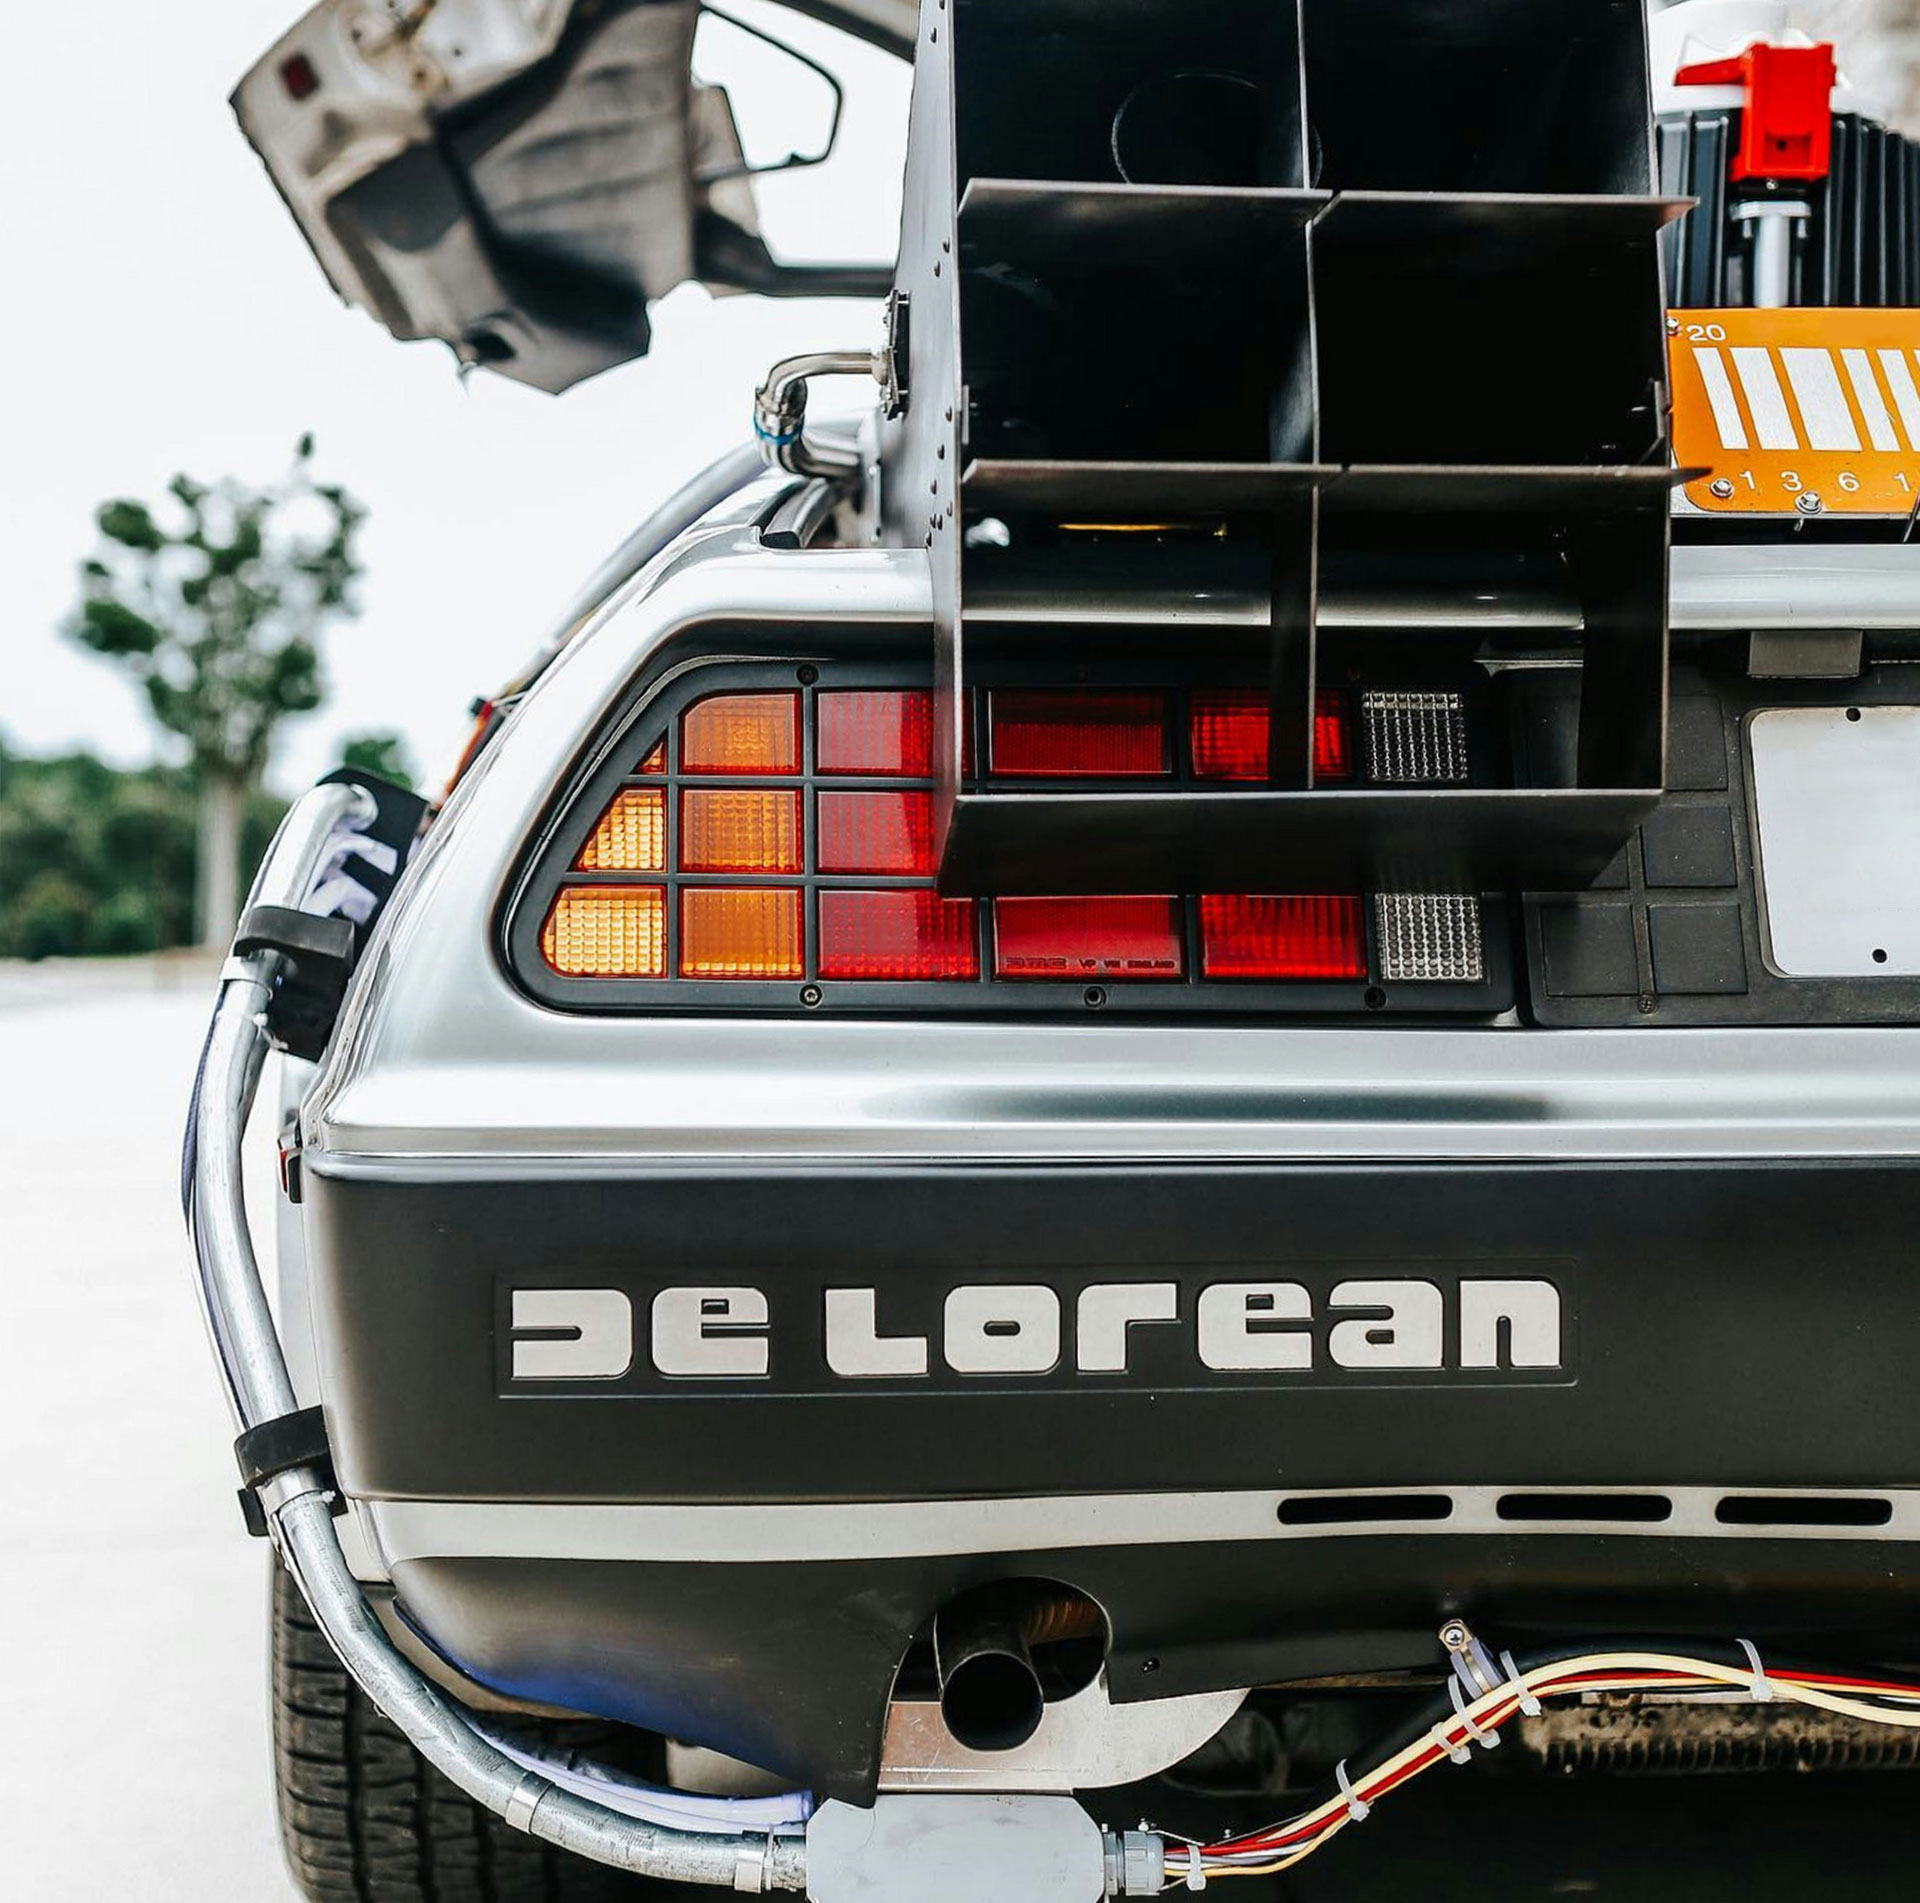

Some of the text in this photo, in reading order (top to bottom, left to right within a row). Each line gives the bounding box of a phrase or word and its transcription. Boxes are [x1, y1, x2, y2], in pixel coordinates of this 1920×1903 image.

[1686, 324, 1726, 341] 20
[1739, 470, 1755, 490] 1
[1780, 471, 1803, 492] 3
[1838, 471, 1860, 492] 6
[1127, 959, 1175, 969] ENGLAND
